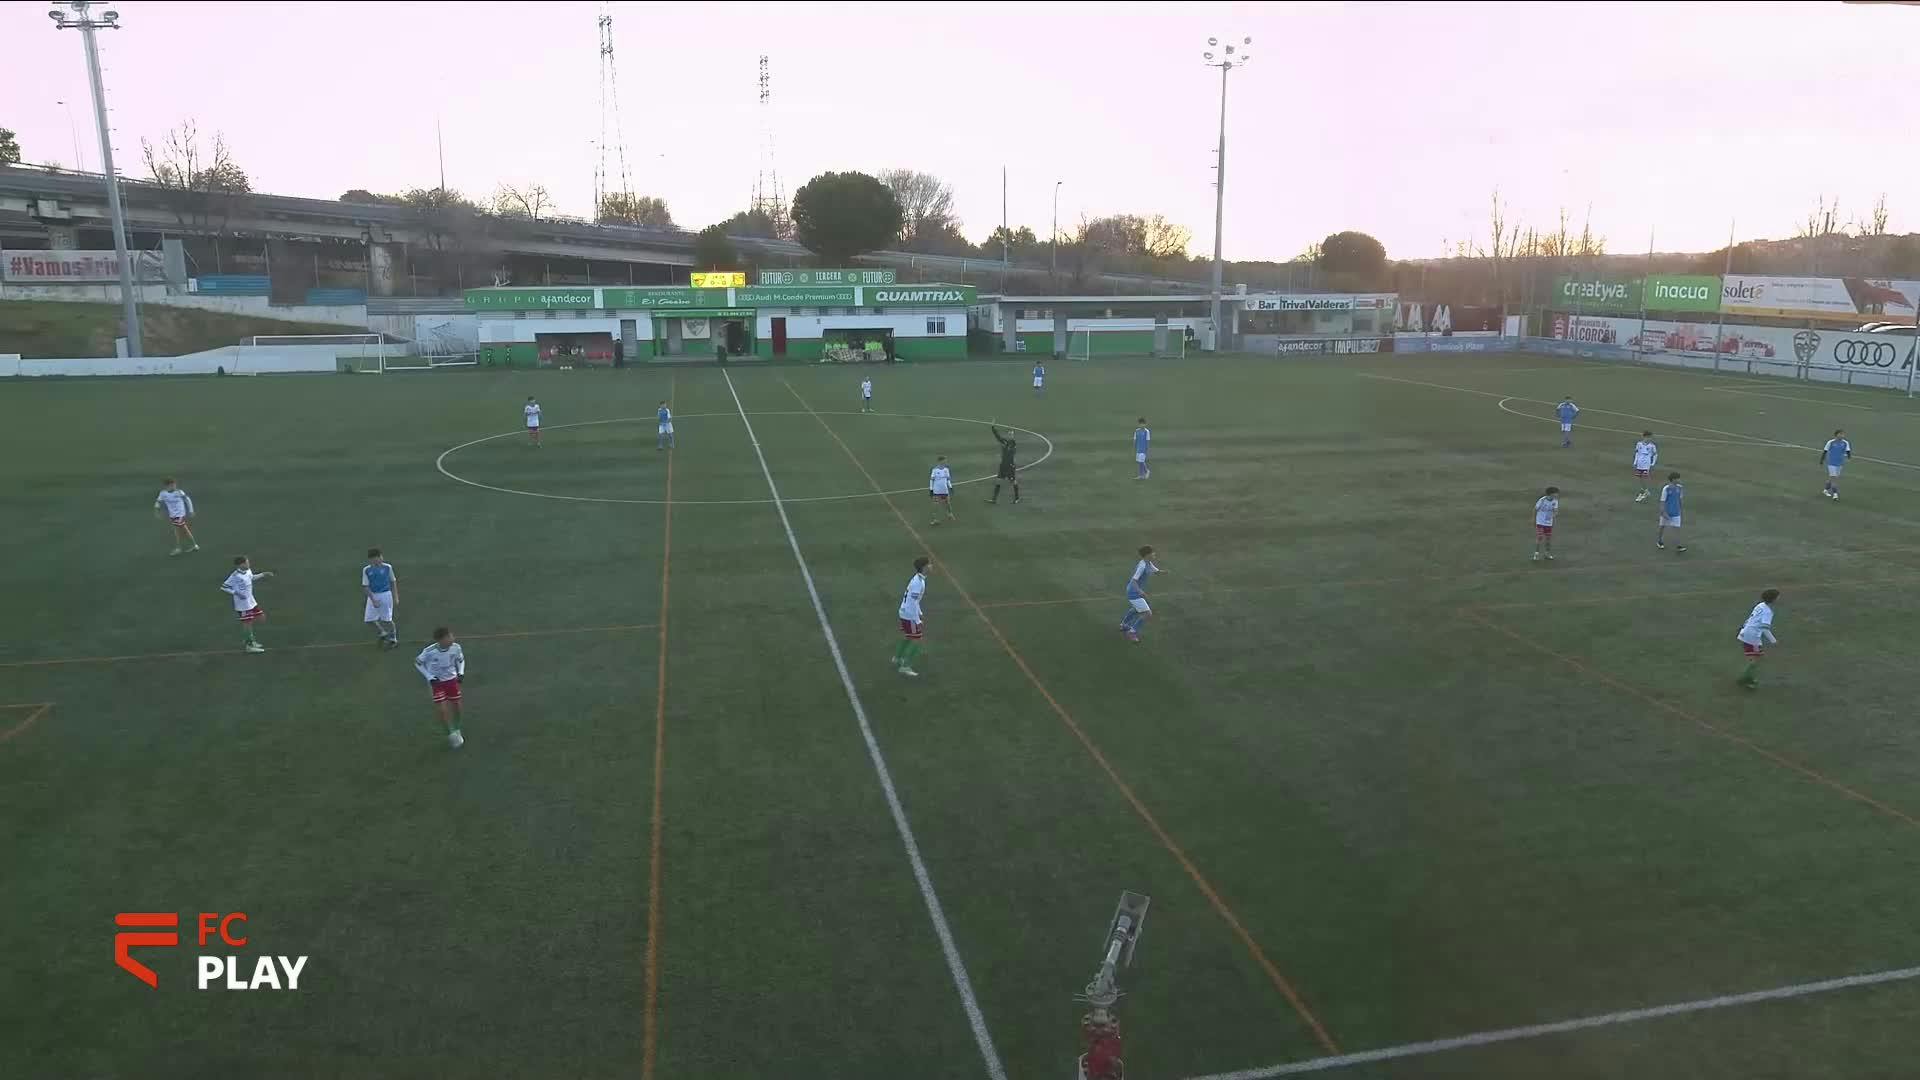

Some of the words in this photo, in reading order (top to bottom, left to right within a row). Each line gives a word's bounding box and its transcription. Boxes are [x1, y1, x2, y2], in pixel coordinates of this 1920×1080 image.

[875, 290, 965, 301] QUAMTRAX
[1655, 281, 1709, 300] inacua
[541, 294, 591, 308] afandecor
[1258, 300, 1276, 309] Bar
